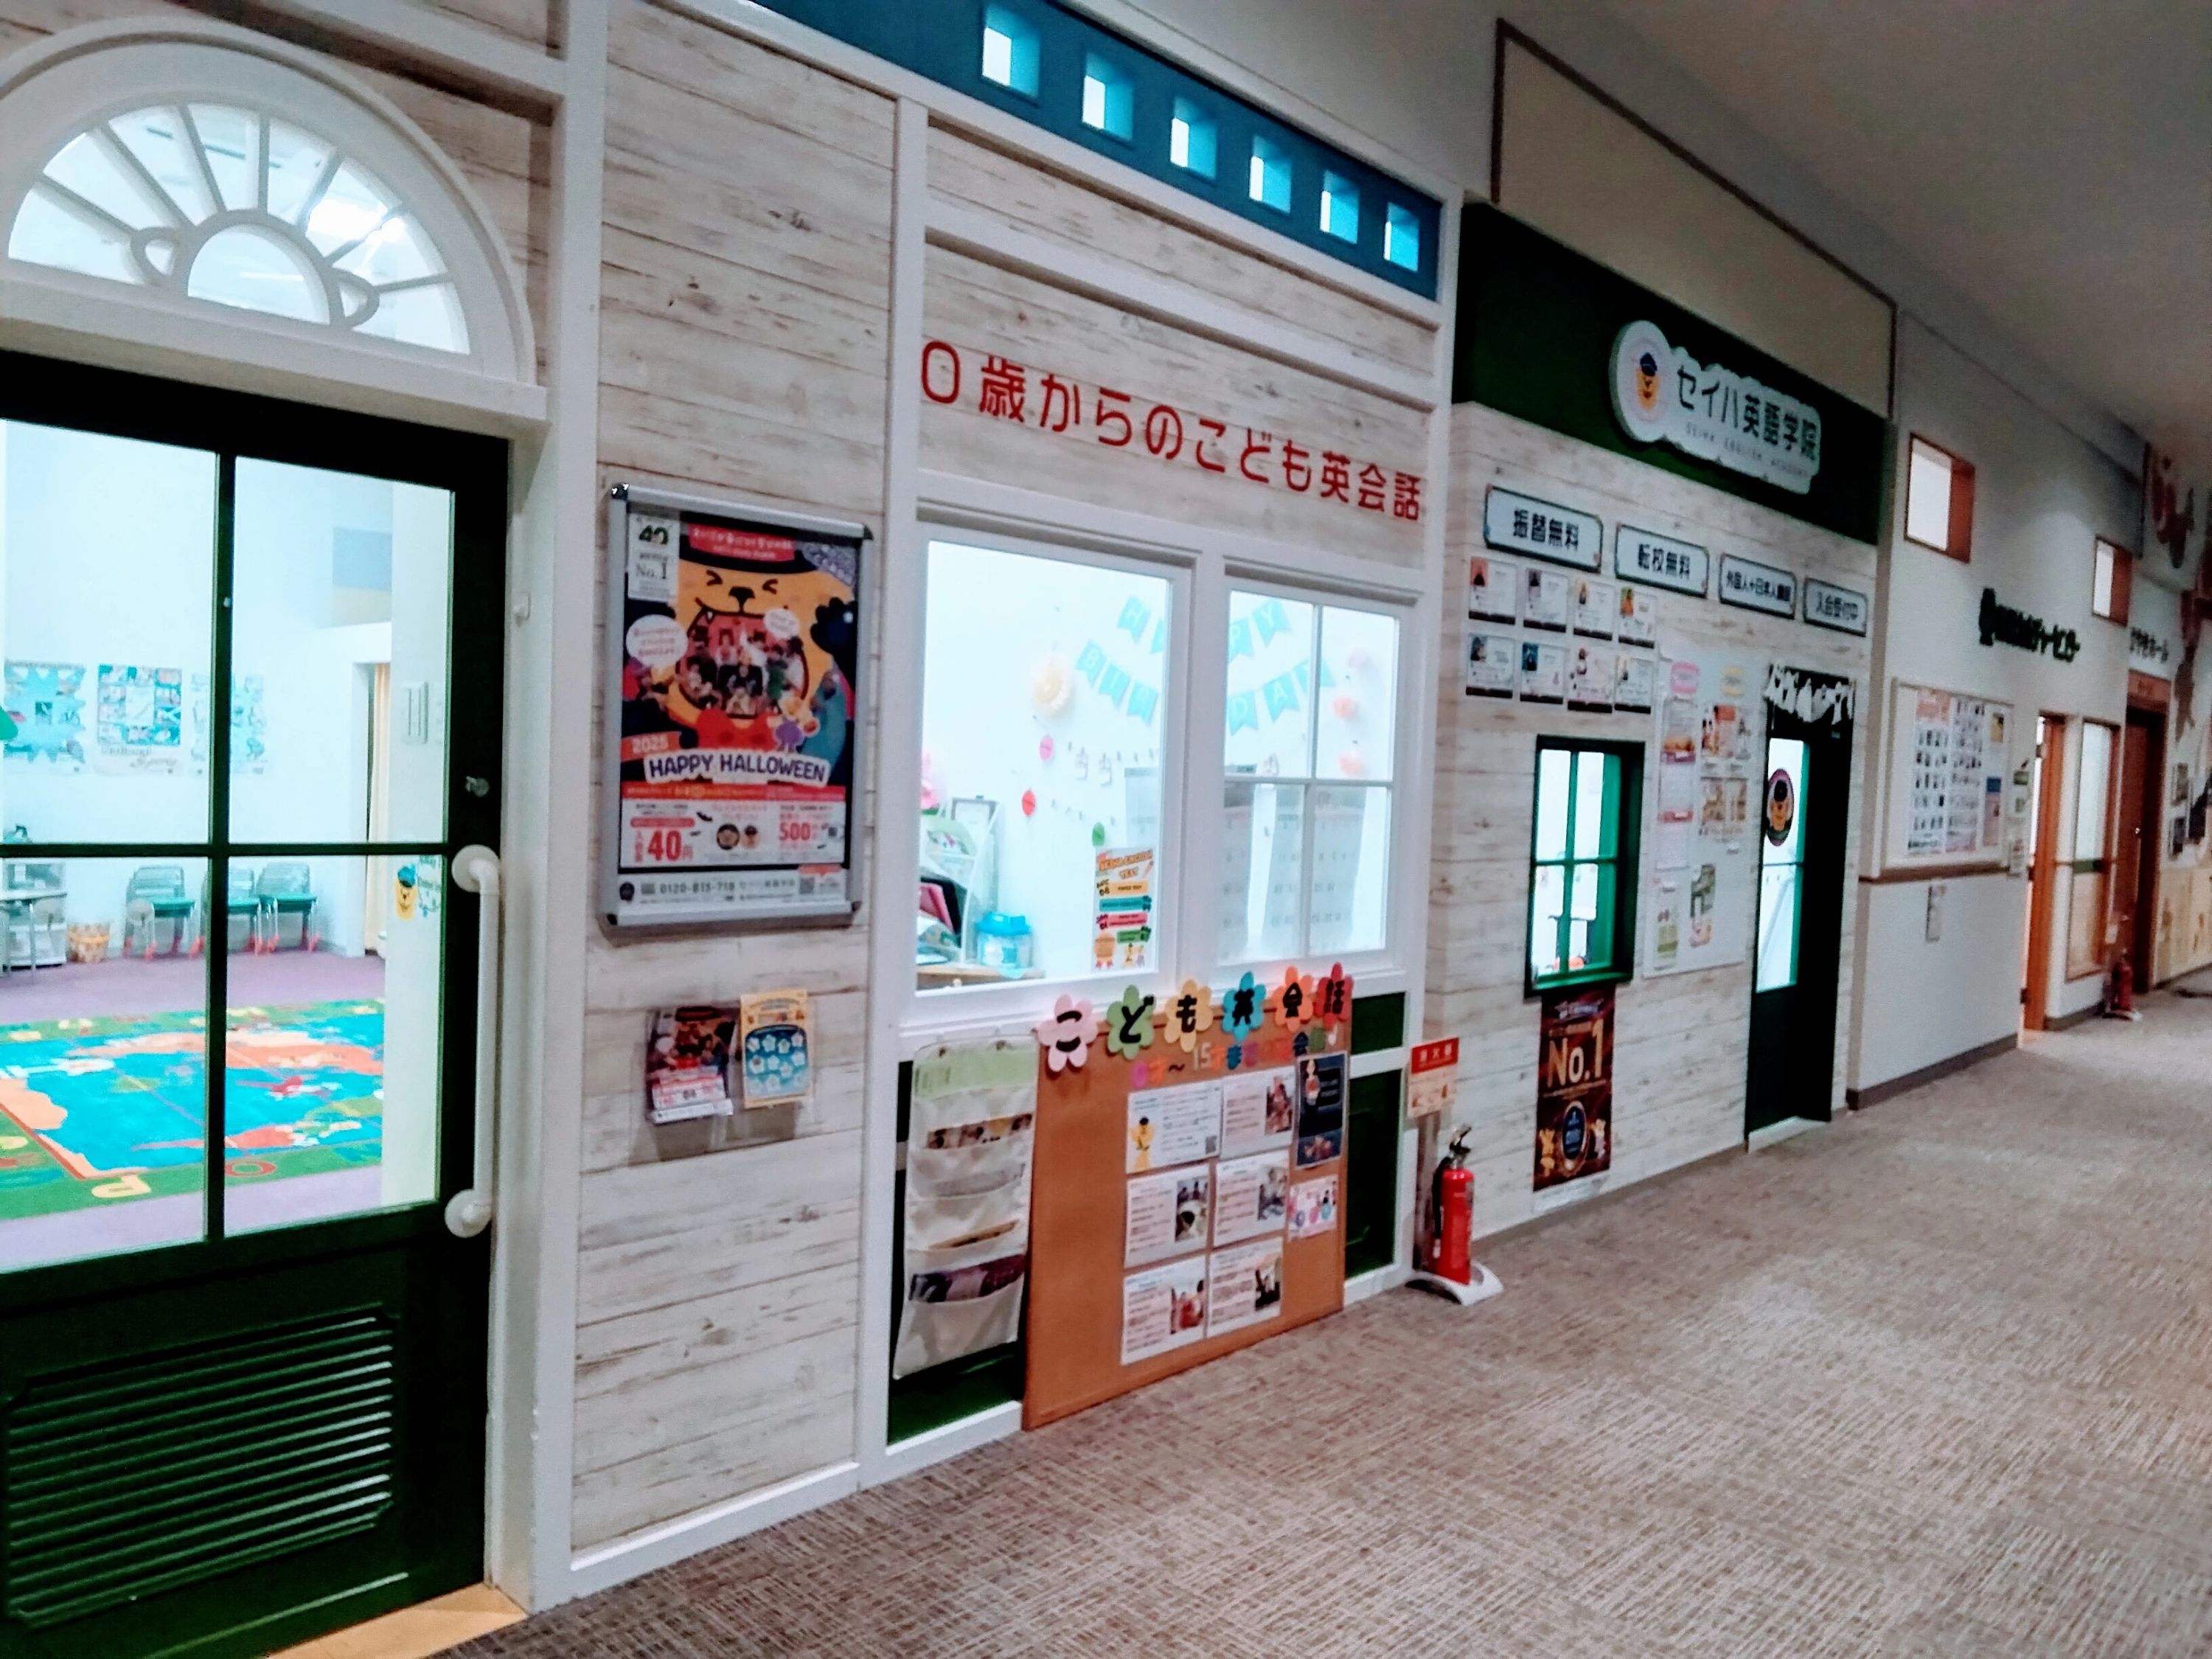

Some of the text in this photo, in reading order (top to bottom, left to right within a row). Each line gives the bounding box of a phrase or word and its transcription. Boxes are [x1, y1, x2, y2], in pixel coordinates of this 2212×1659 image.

[649, 754, 825, 782] HAPPY HALLOWEEN
[1546, 1018, 1604, 1088] No.1
